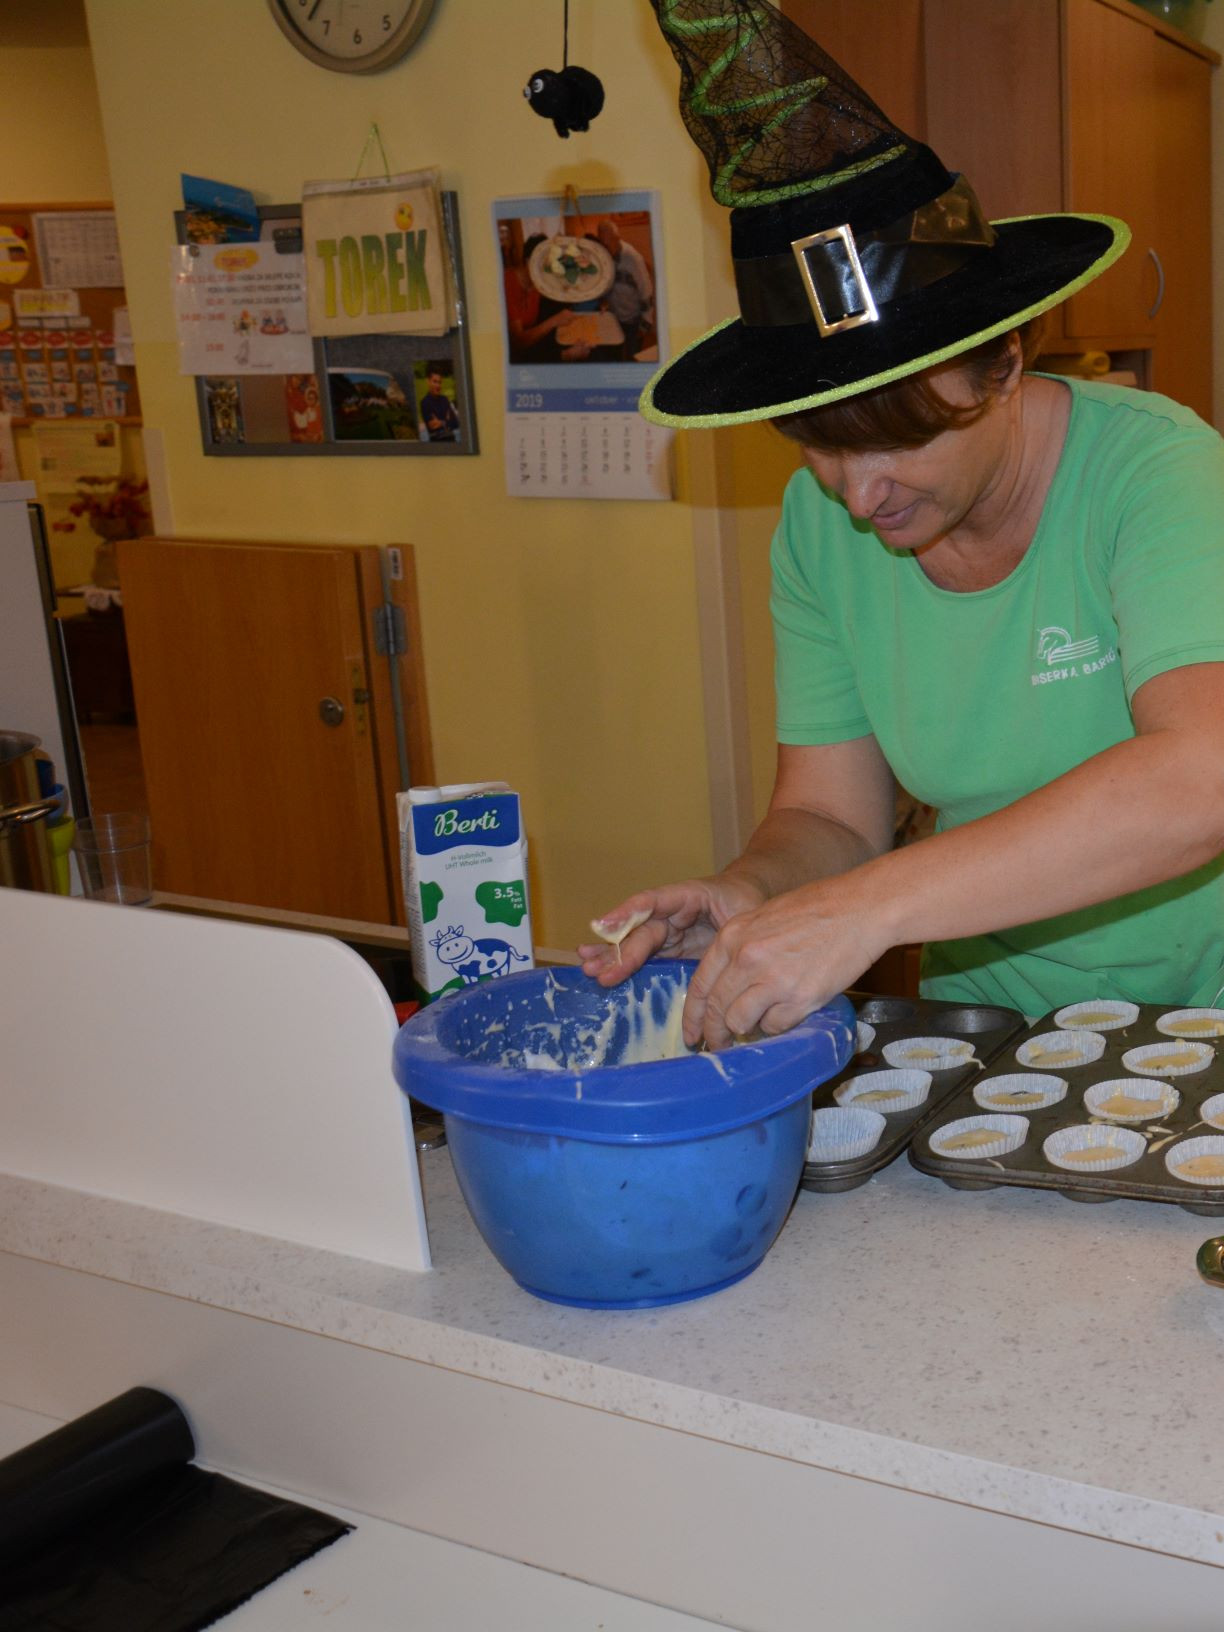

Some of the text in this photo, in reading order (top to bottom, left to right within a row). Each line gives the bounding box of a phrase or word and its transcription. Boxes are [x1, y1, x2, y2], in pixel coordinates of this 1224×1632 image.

[322, 20, 331, 36] 7
[382, 15, 391, 31] 5
[353, 29, 362, 44] 6
[315, 229, 432, 318] TOREK
[515, 392, 544, 408] 2019
[433, 809, 500, 837] Berti
